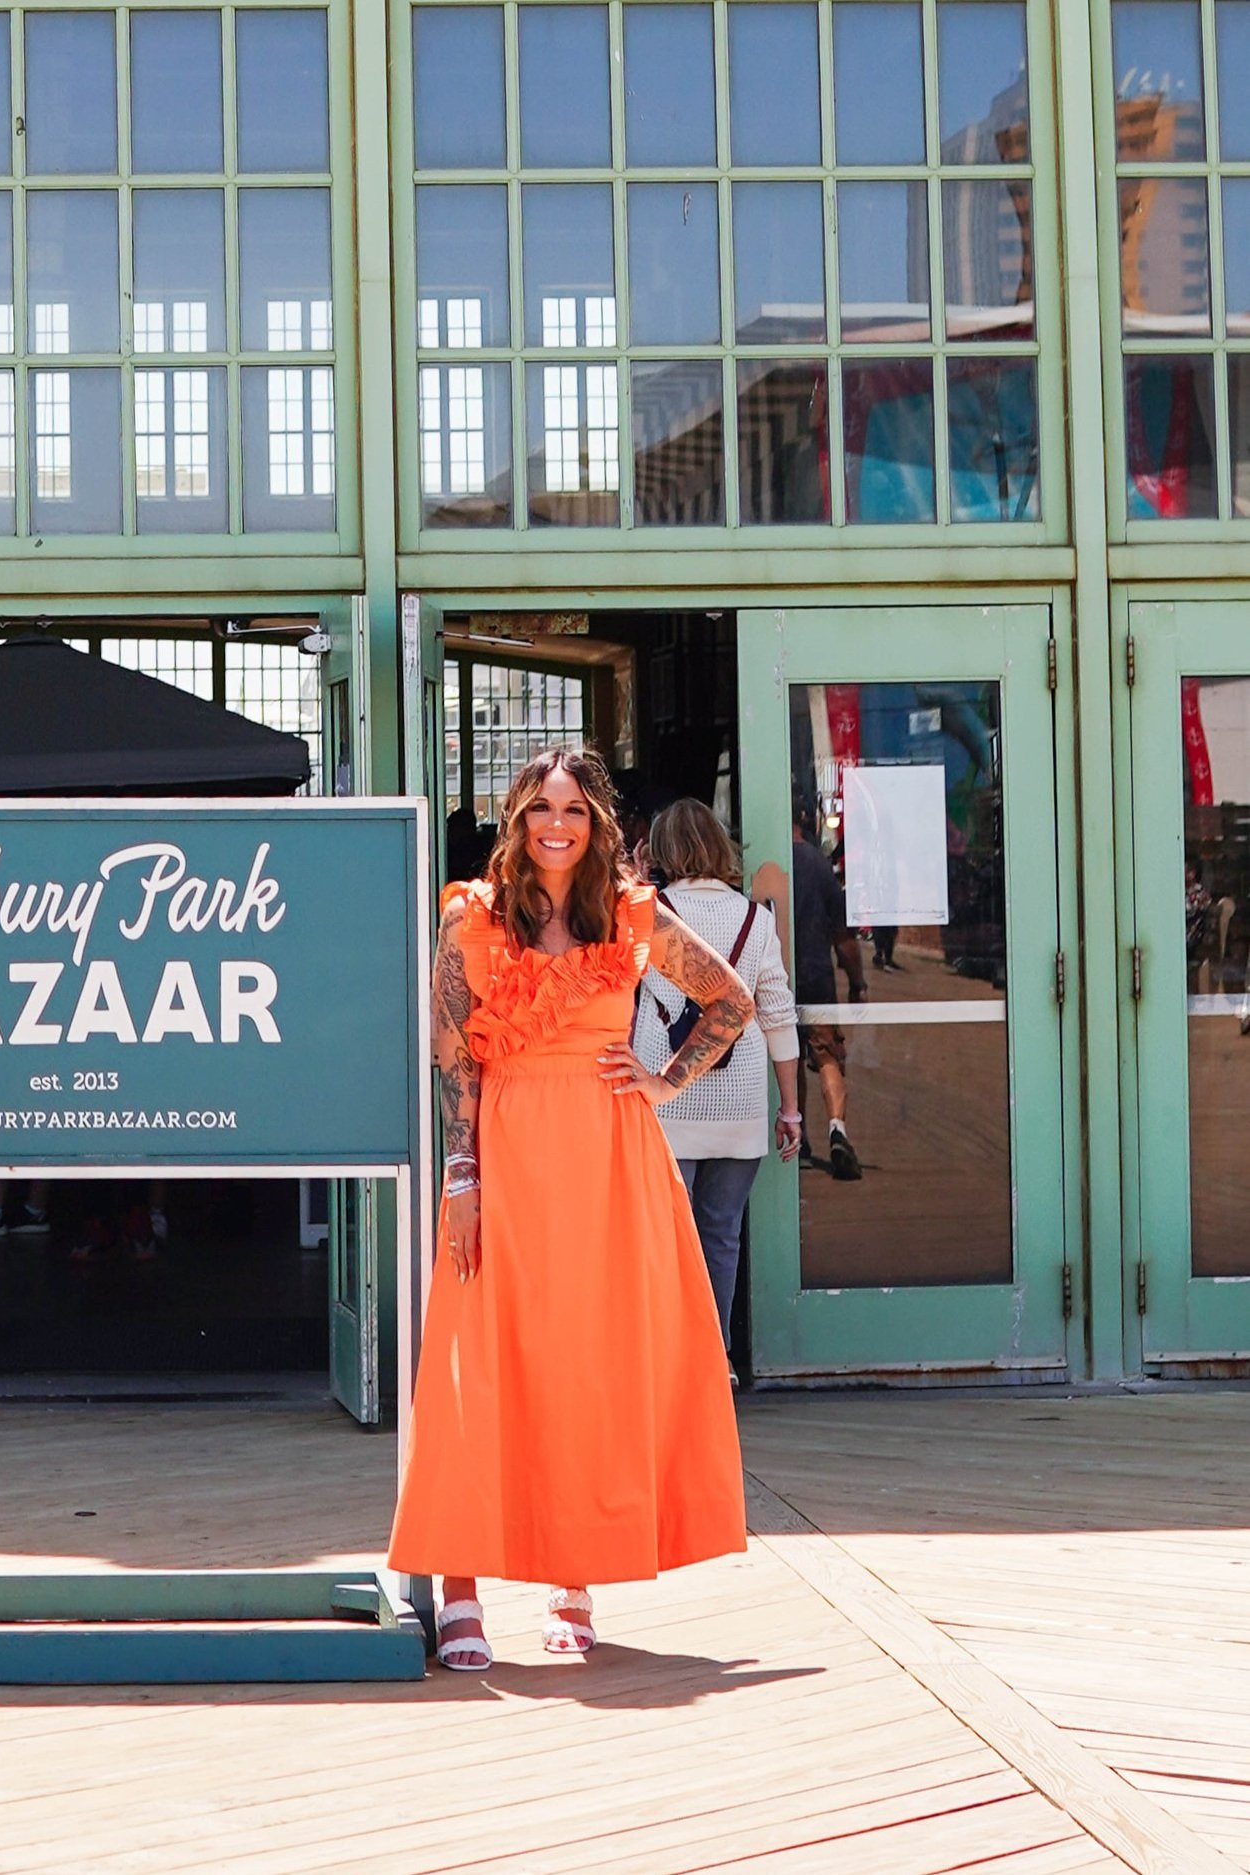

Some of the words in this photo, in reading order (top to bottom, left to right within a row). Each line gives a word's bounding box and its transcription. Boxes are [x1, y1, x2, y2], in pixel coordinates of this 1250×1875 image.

[99, 842, 287, 941] Park
[29, 1073, 63, 1091] est.
[73, 1072, 119, 1091] 2013
